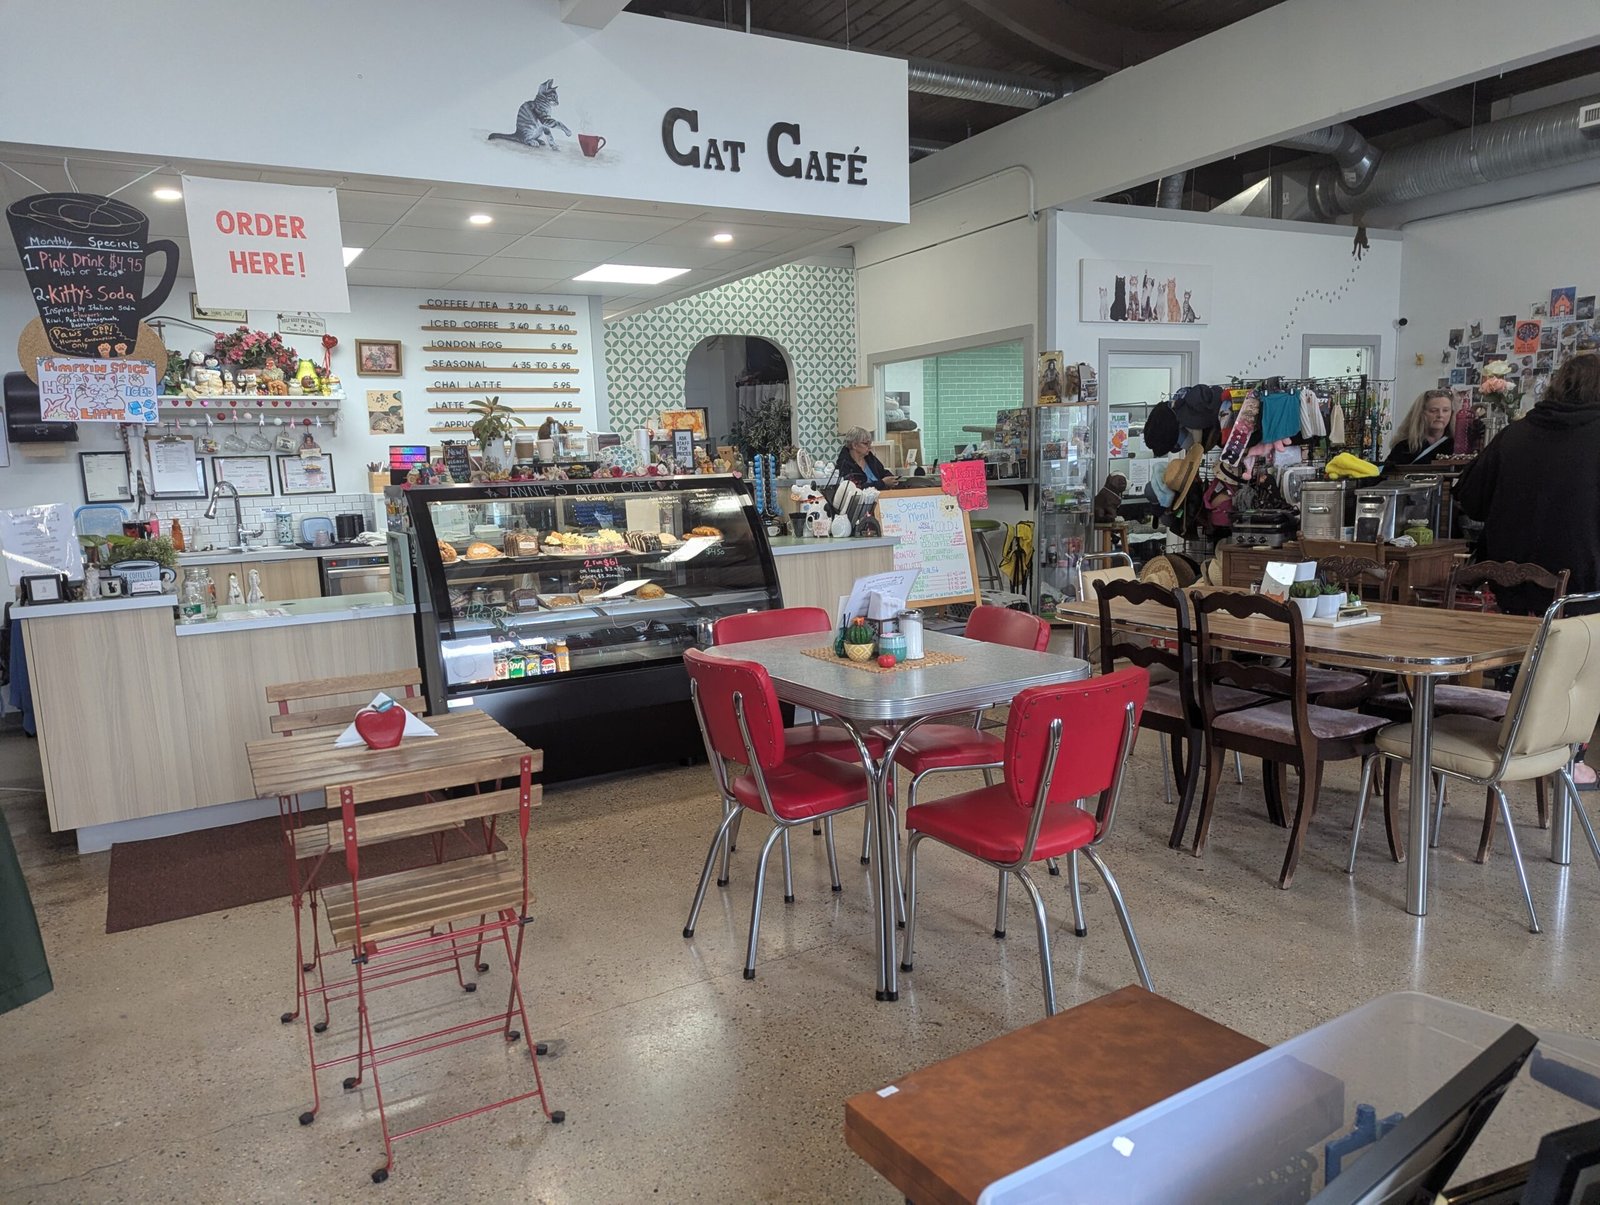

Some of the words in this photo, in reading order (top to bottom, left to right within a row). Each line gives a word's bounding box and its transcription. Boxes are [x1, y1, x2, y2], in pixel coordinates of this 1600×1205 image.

[216, 210, 307, 239] ORDER
[30, 237, 72, 249] Monthly
[88, 236, 140, 249] Specials
[23, 254, 39, 271] 1.
[40, 251, 69, 270] Pink
[73, 252, 105, 268] Drink
[109, 253, 143, 273] $4.95
[229, 250, 306, 278] HERE!
[33, 287, 49, 301] 2.
[48, 284, 93, 305] Kitty's
[97, 285, 136, 302] Soda
[479, 301, 499, 309] TEA
[43, 306, 74, 317] Inspired
[430, 320, 457, 328] ICED
[463, 321, 499, 329] COFFEE
[53, 328, 82, 339] Paws
[431, 340, 476, 348] LONDON
[482, 341, 503, 349] FOG
[432, 360, 487, 368] SEASONAL
[126, 386, 154, 397] ICED
[436, 401, 464, 409] LATTE
[81, 408, 125, 420] LATTE
[509, 482, 568, 498] ANNIE'S
[575, 482, 616, 495] ATTIC
[897, 497, 938, 513] Seasonal
